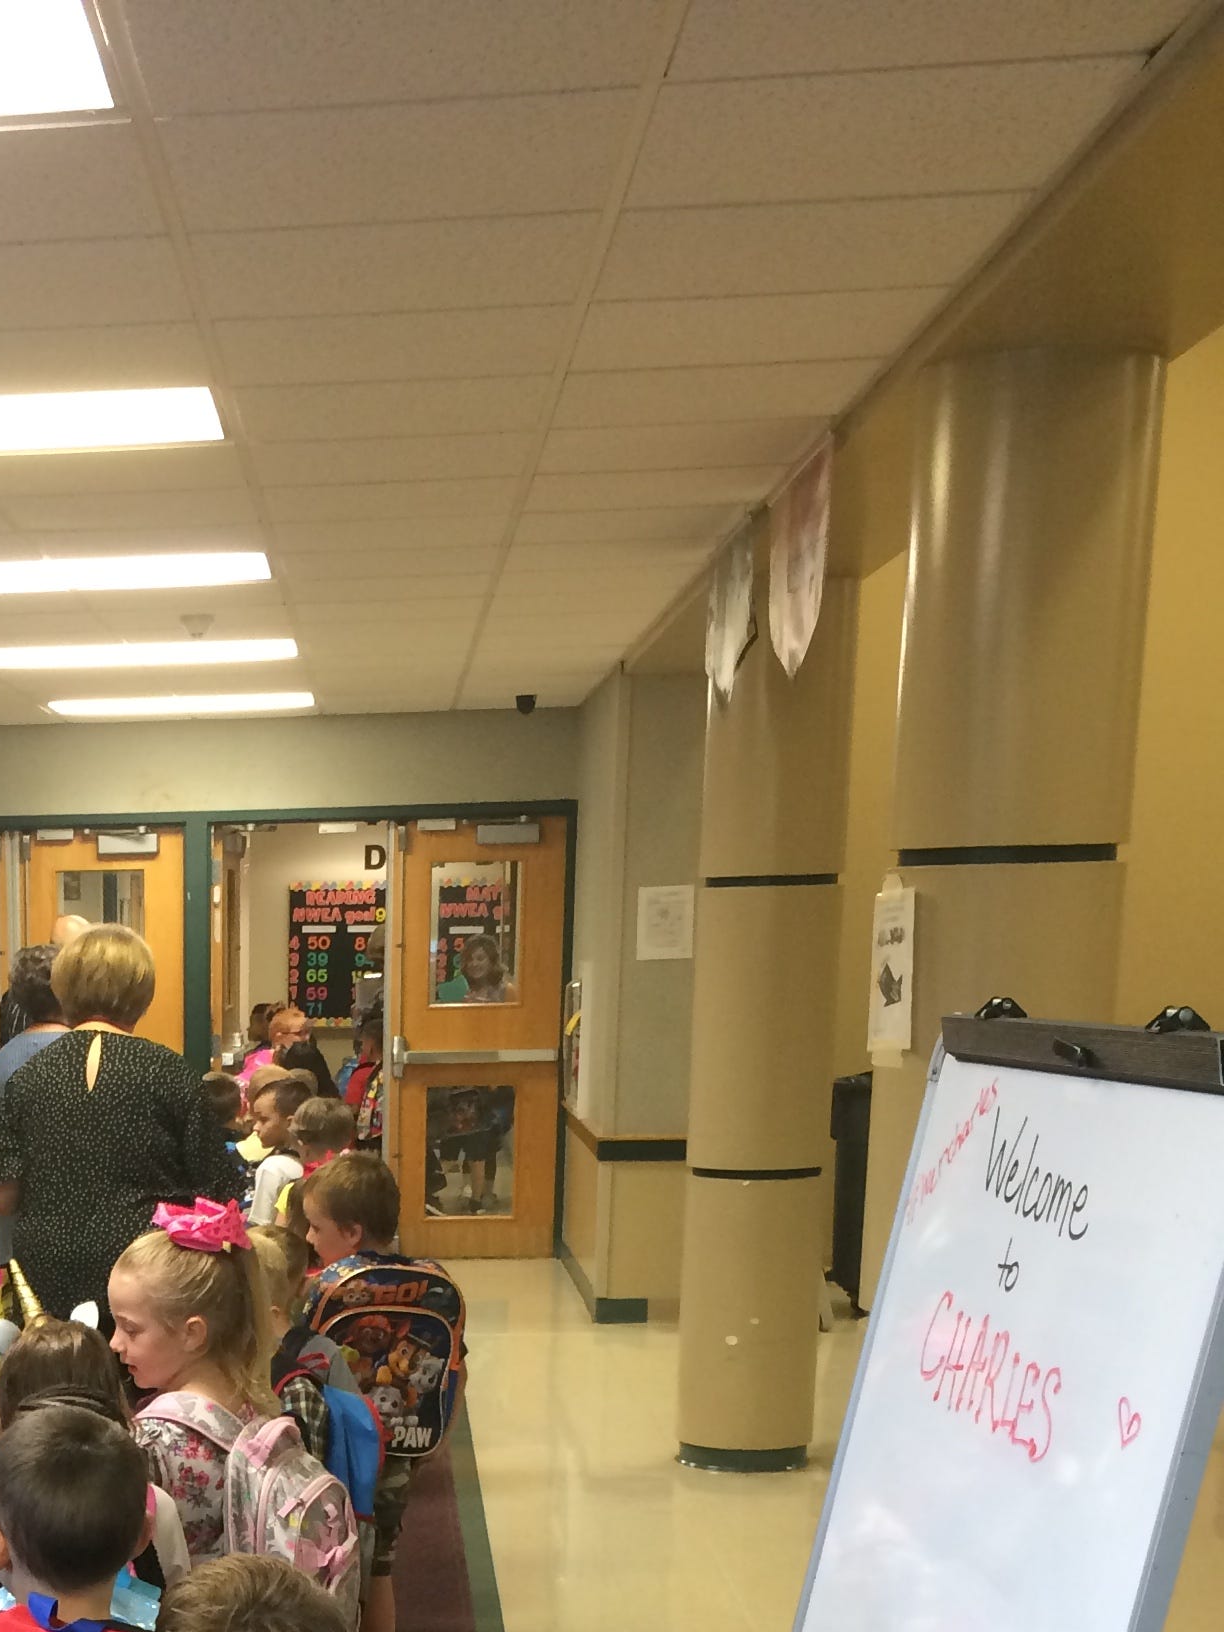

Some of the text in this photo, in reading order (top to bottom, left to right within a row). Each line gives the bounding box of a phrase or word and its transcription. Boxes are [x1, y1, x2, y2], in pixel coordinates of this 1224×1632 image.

[365, 845, 387, 870] D
[305, 890, 376, 906] READING
[293, 906, 342, 922] NWEA
[307, 936, 331, 950] 50
[307, 952, 329, 967] 39
[306, 969, 328, 983] 65
[306, 1002, 324, 1016] 71
[985, 1106, 1089, 1241] Welcome
[997, 1237, 1020, 1293] to
[920, 1290, 1062, 1463] CHARLES
[391, 1426, 432, 1448] PAW
